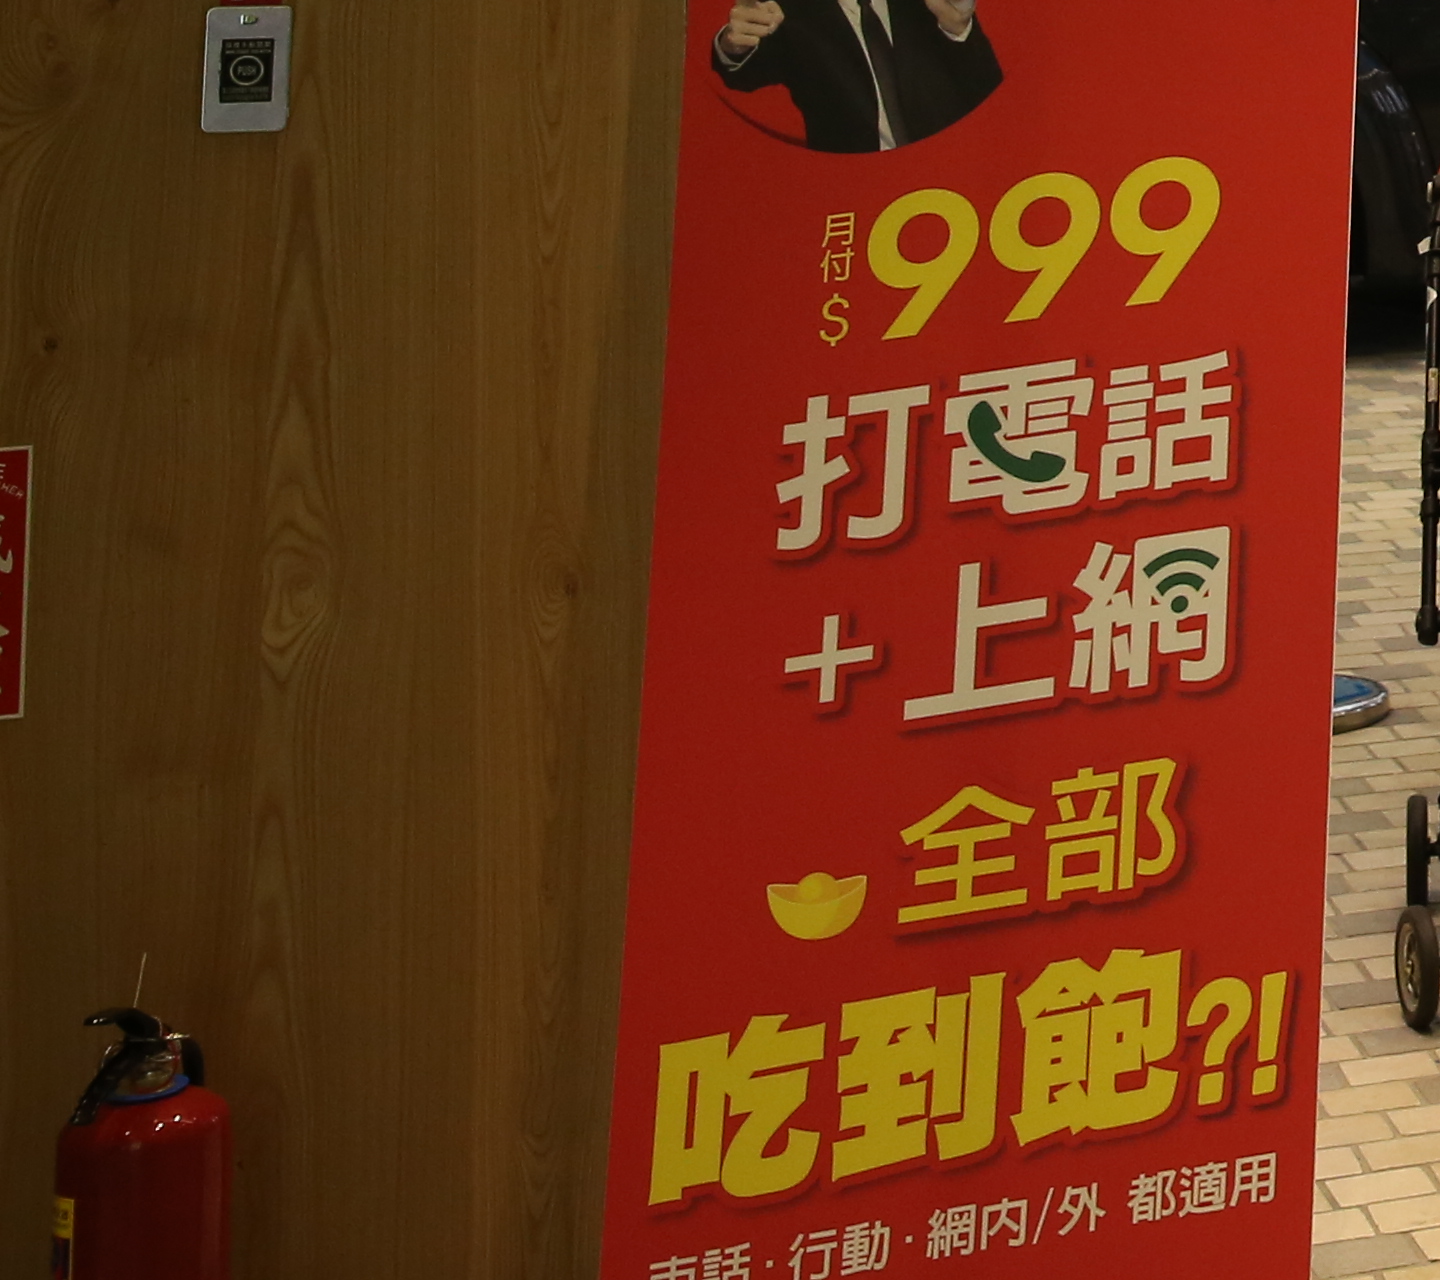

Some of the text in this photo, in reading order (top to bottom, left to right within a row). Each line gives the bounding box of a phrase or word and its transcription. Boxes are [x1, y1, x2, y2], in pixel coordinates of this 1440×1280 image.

[867, 156, 1221, 340] 999
[774, 350, 1233, 552] 打電話
[902, 526, 1232, 722] 上網
[897, 757, 1177, 924] 全部
[1127, 1152, 1277, 1224] 都適用
